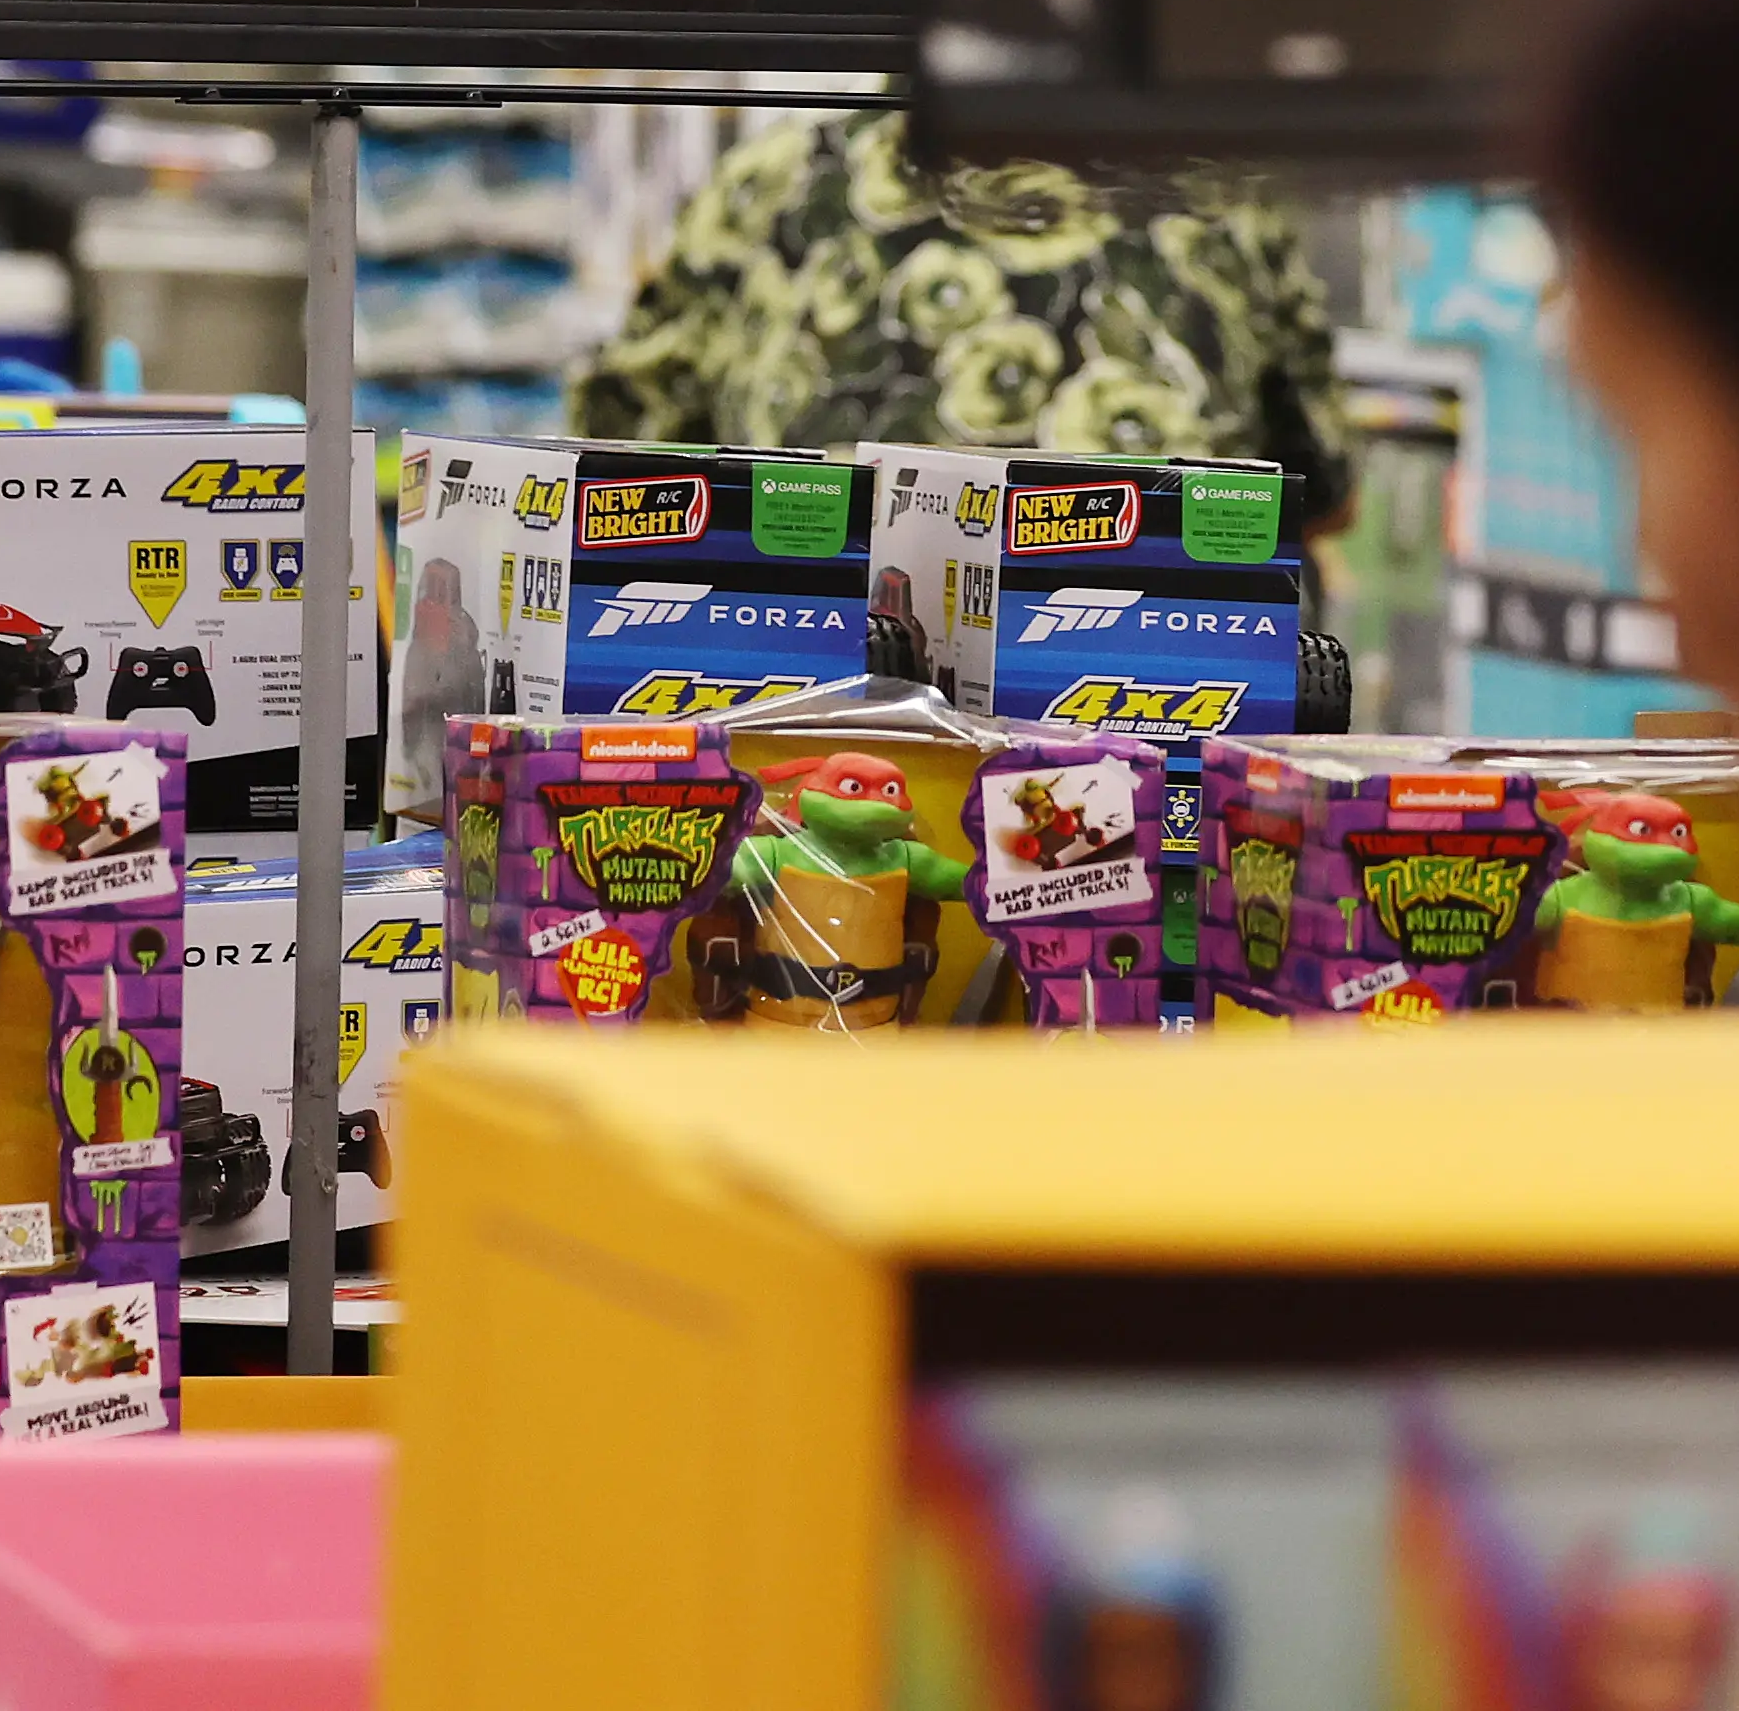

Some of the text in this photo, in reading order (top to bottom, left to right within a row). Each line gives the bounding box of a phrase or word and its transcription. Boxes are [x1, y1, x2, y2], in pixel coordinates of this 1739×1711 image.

[468, 484, 507, 507] FORZA
[589, 488, 683, 513] NEW R/C
[778, 482, 841, 495] GAME PASS
[1208, 488, 1273, 502] GAME PASS
[212, 497, 300, 511] RADIO CONTROL
[915, 491, 949, 516] FORZA
[1018, 494, 1112, 520] NEW R/C
[587, 510, 684, 539] BRIGHT
[1016, 516, 1115, 545] BRIGHT
[136, 547, 180, 570] RTR
[709, 604, 846, 630] FORZA
[1140, 610, 1277, 636] FORZA
[1101, 719, 1185, 735] RADIO CONTROL
[589, 741, 689, 758] nickelodeon
[559, 804, 725, 889] TURTLES
[601, 855, 689, 881] MUTANT
[608, 882, 682, 907] MAYHEM
[994, 885, 1035, 905] RAMP
[1038, 869, 1105, 893] INCLUDED
[1036, 888, 1074, 908] SKATE
[1364, 854, 1529, 939] TURTLES
[1405, 906, 1493, 934] MUTANT
[394, 957, 431, 971] RADIO
[577, 976, 622, 1012] RC!
[27, 1392, 131, 1430] MOVE AROUND
